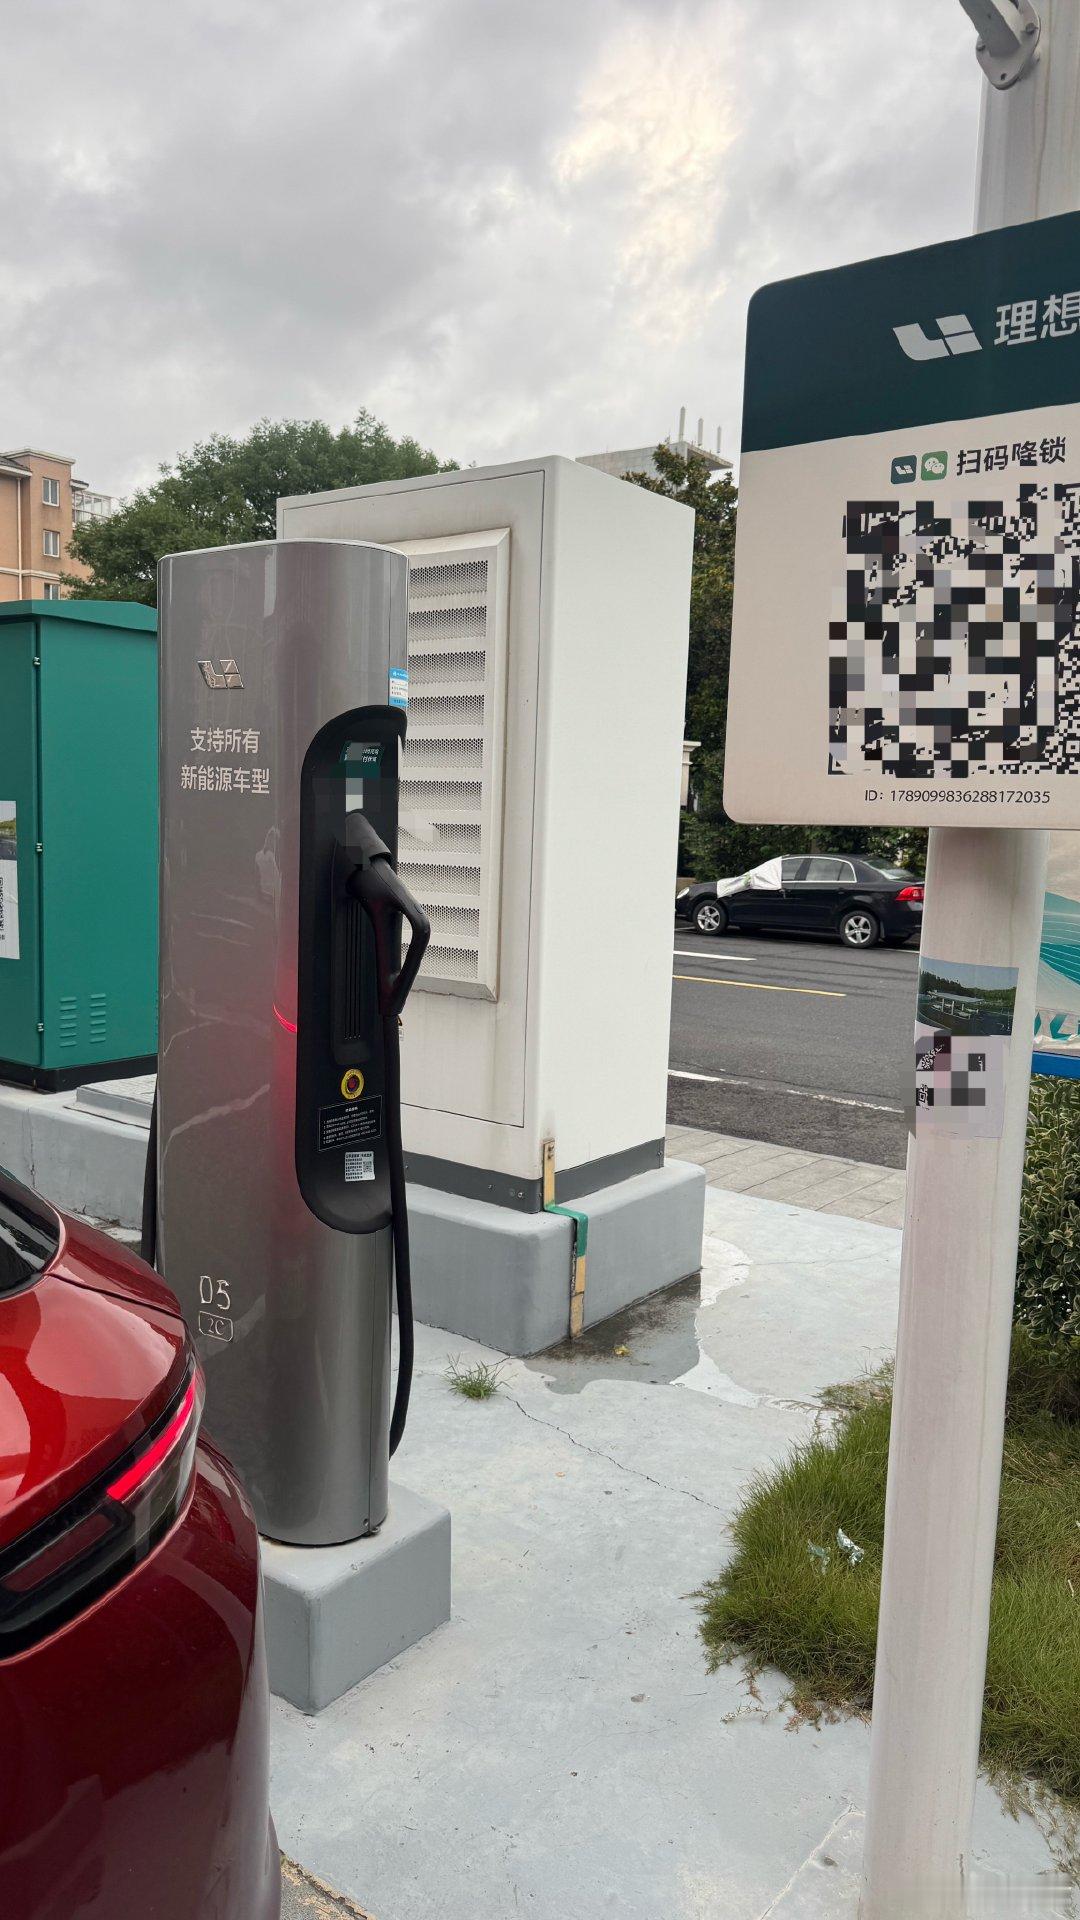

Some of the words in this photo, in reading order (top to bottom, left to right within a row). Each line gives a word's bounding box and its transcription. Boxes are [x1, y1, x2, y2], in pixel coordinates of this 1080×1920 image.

[993, 290, 1080, 346] 理想
[190, 727, 261, 754] 支持所有
[180, 765, 270, 794] 新能源车型
[890, 789, 1051, 804] 1789099836288172035
[199, 1275, 231, 1310] 05
[207, 1317, 225, 1336] 2C
